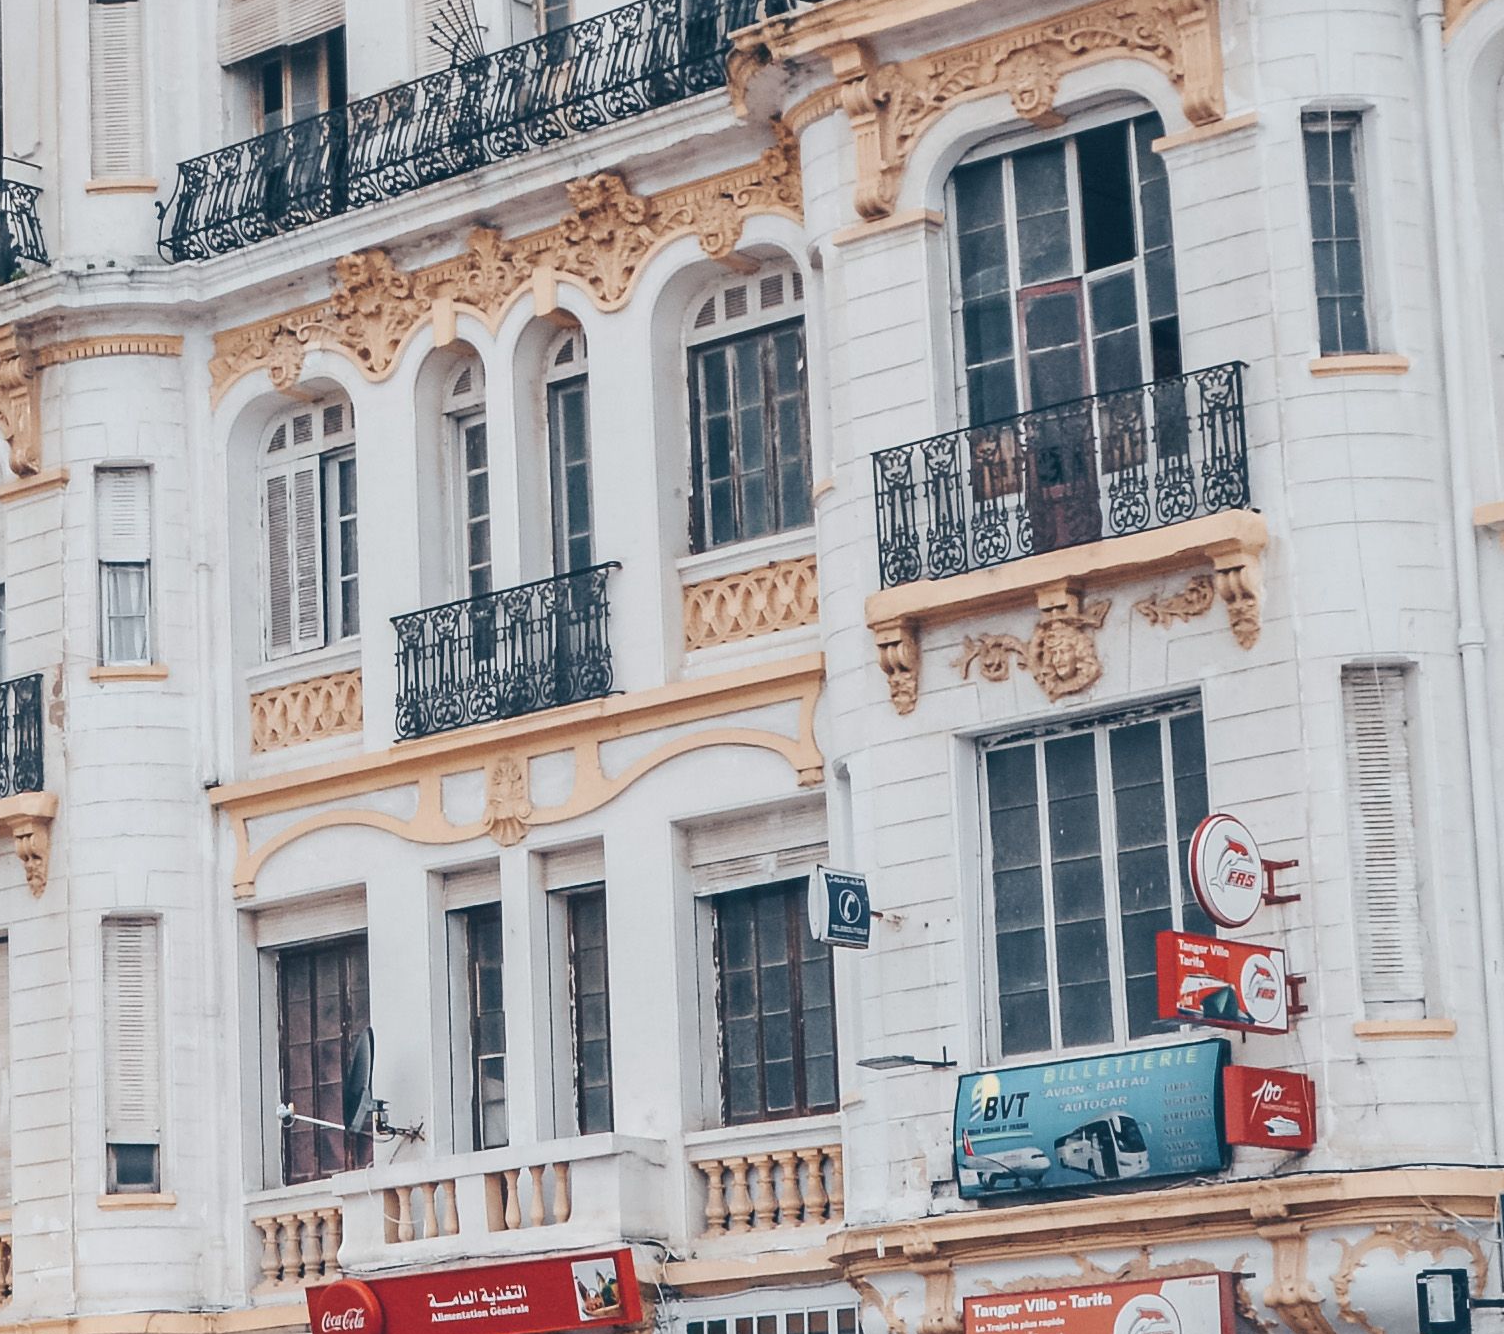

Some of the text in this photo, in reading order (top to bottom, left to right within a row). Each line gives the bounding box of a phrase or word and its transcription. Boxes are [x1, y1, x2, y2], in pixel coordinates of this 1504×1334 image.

[1226, 870, 1256, 889] FRS
[1178, 939, 1230, 958] Tanger Ville
[1179, 954, 1205, 968] Tarifa
[1256, 987, 1276, 1000] FRS
[1043, 1048, 1198, 1084] BILLETTERIE
[1096, 1076, 1150, 1092] BATEAU
[983, 1092, 1030, 1121] BVT
[480, 1284, 528, 1306] التغذية
[431, 1303, 529, 1323] Alimentation Générale
[972, 1302, 1022, 1319] Tanger
[1024, 1299, 1057, 1314] Ville
[1068, 1292, 1112, 1309] Tarifa
[321, 1307, 365, 1332] Coca-Cola
